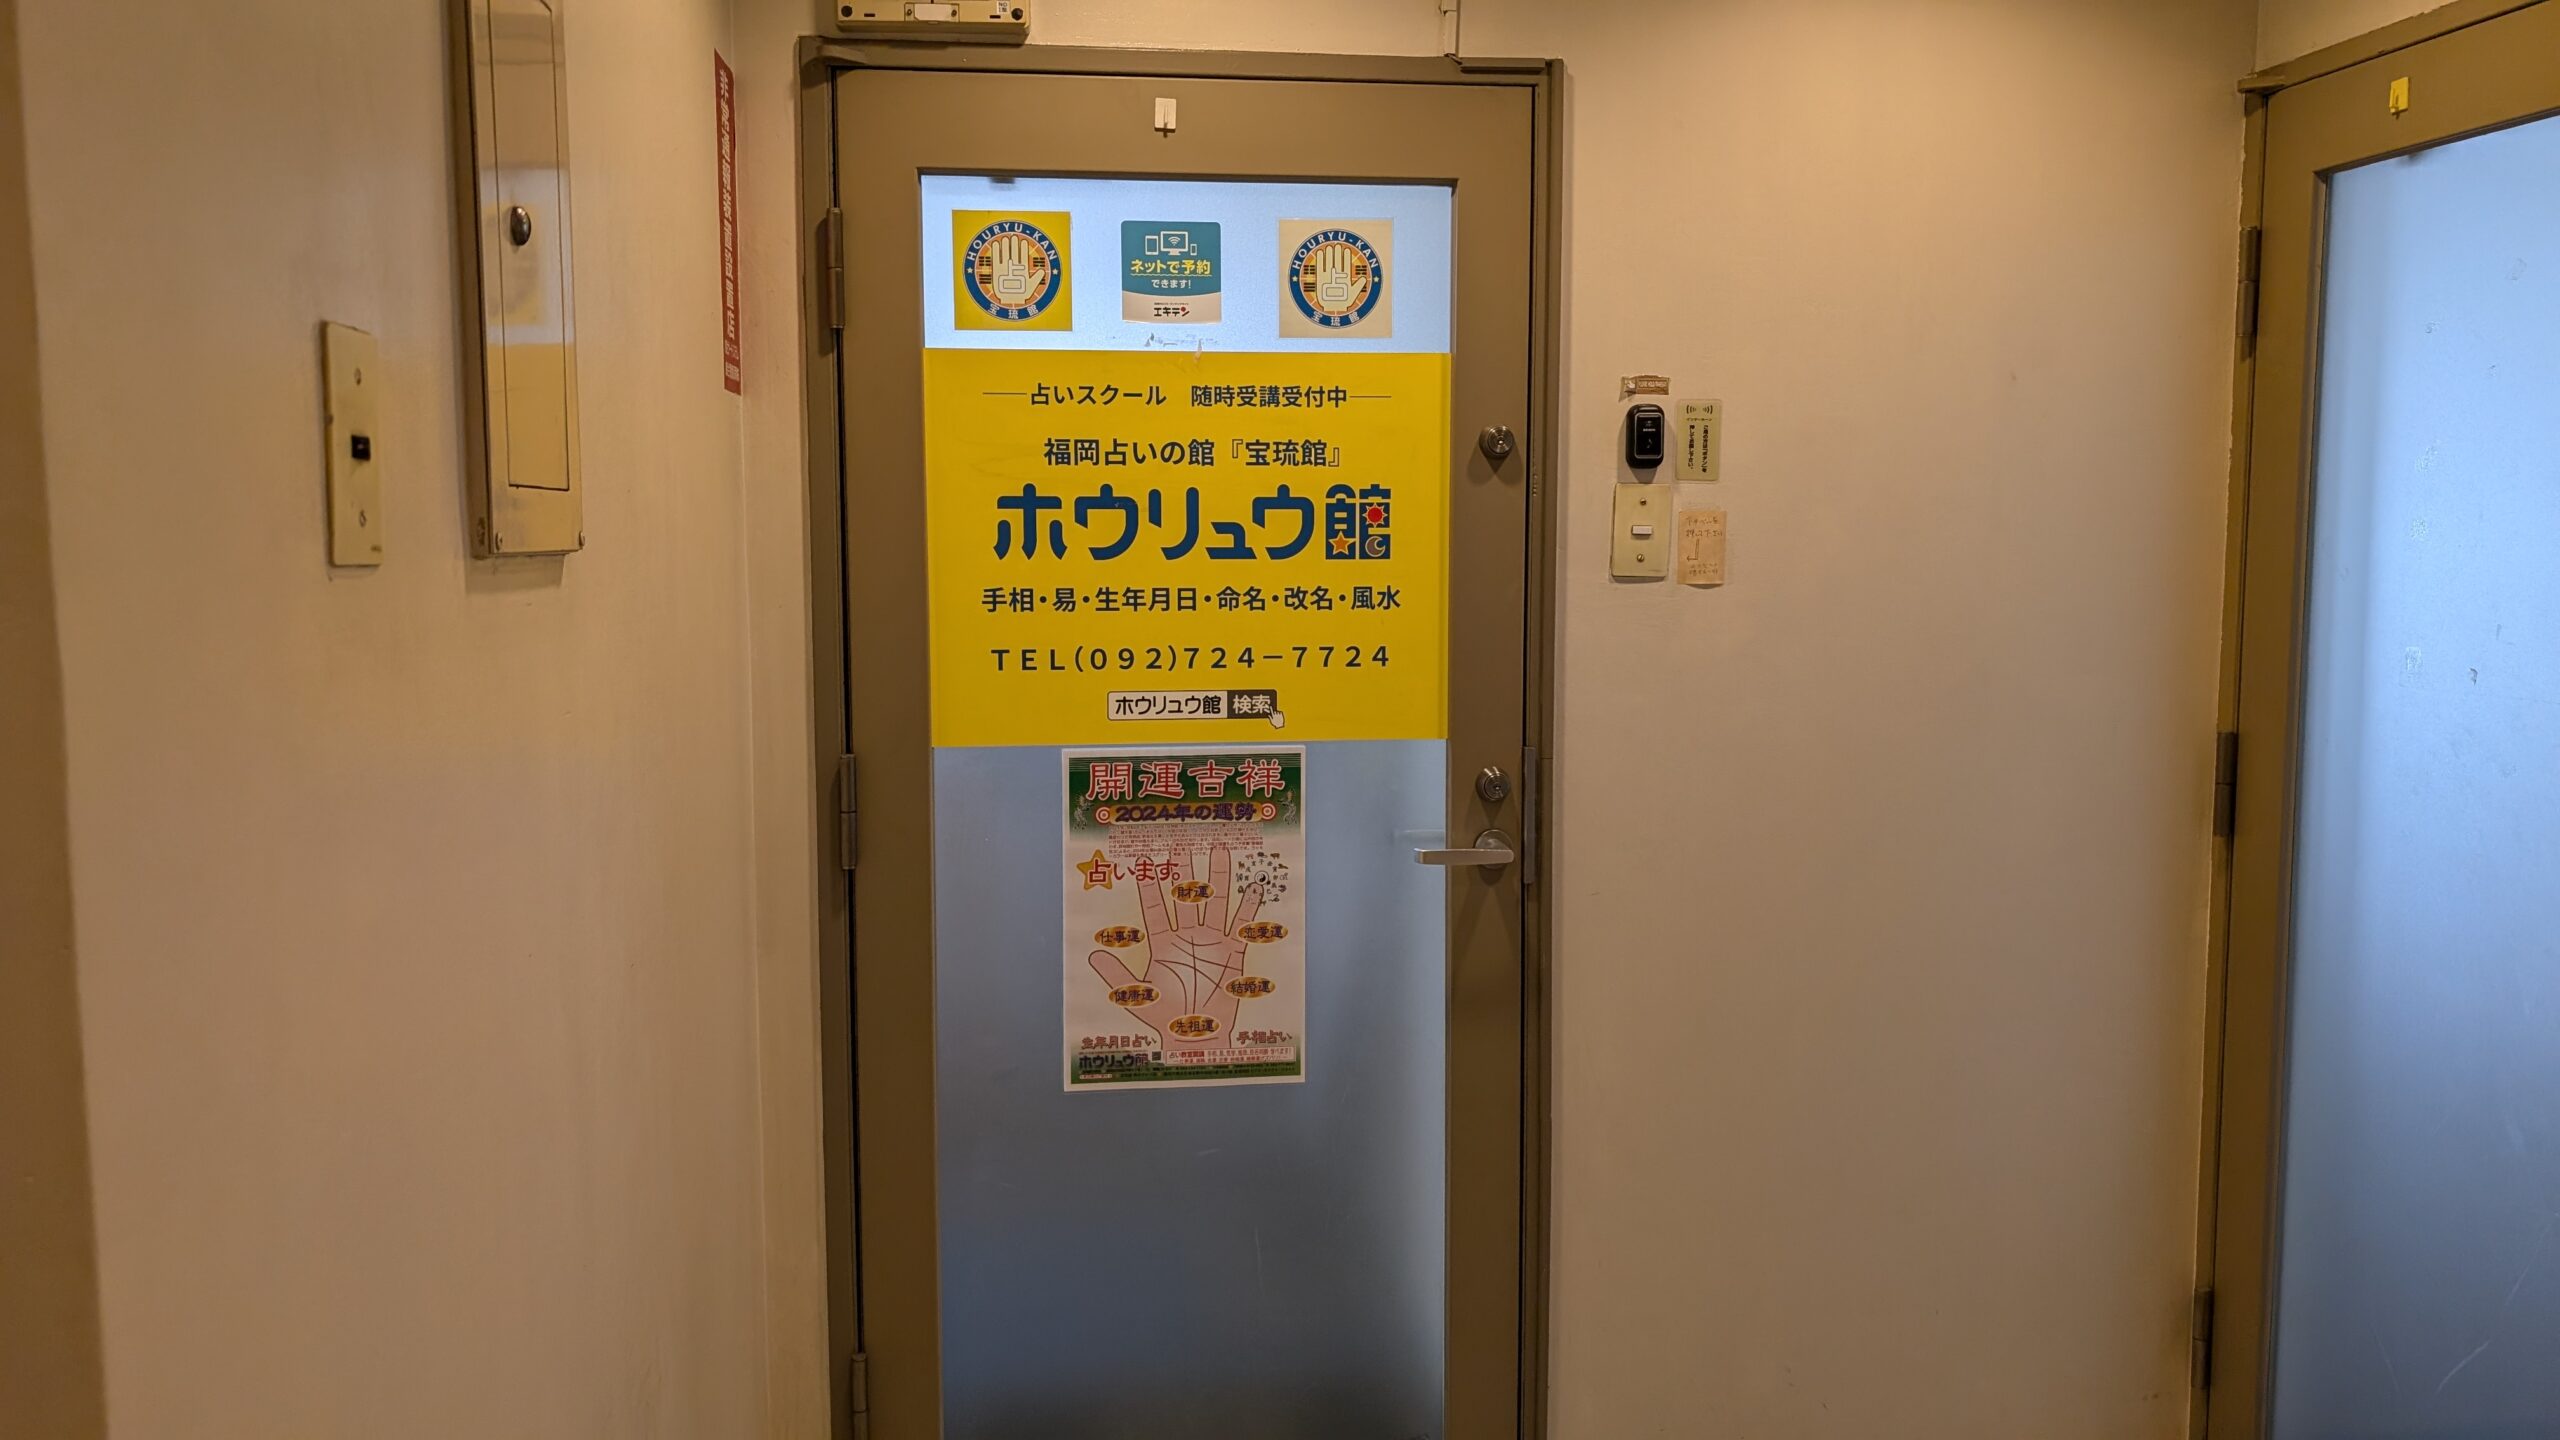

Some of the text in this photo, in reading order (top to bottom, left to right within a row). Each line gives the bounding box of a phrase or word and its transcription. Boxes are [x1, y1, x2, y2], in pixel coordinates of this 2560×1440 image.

[966, 222, 1058, 261] HOURYU-KAN
[1292, 232, 1379, 269] HOURYU-KAN
[1131, 259, 1211, 275] ネットで予約
[987, 303, 1039, 319] 宝琉館
[1154, 306, 1190, 317] エキテン
[1311, 311, 1360, 326] 宝琉館
[1030, 384, 1348, 409] 占いスクール 随時受講受付中
[1043, 438, 1342, 468] 福岡占いの館『宝琉館』
[993, 482, 1392, 560] ホウリュウ館
[981, 585, 1401, 613] 手相・易・生年月日・命名・改名・風水
[1115, 694, 1272, 716] ホウリュウ館 検索
[1086, 758, 1286, 801] 開運吉祥
[1114, 802, 1257, 823] 2024年の運勢
[1088, 859, 1182, 884] 占います。
[1176, 885, 1209, 899] 財運
[1099, 930, 1141, 943] 仕事運
[1244, 926, 1283, 940] 恋愛運
[1114, 988, 1154, 1003] 健康運
[1231, 981, 1270, 995] 結婚運
[1175, 1019, 1214, 1033] 先祖運
[1082, 1033, 1157, 1049] 生年月日占い
[1236, 1029, 1292, 1045] 手相占い
[1079, 1052, 1149, 1069] ホウリュウ館
